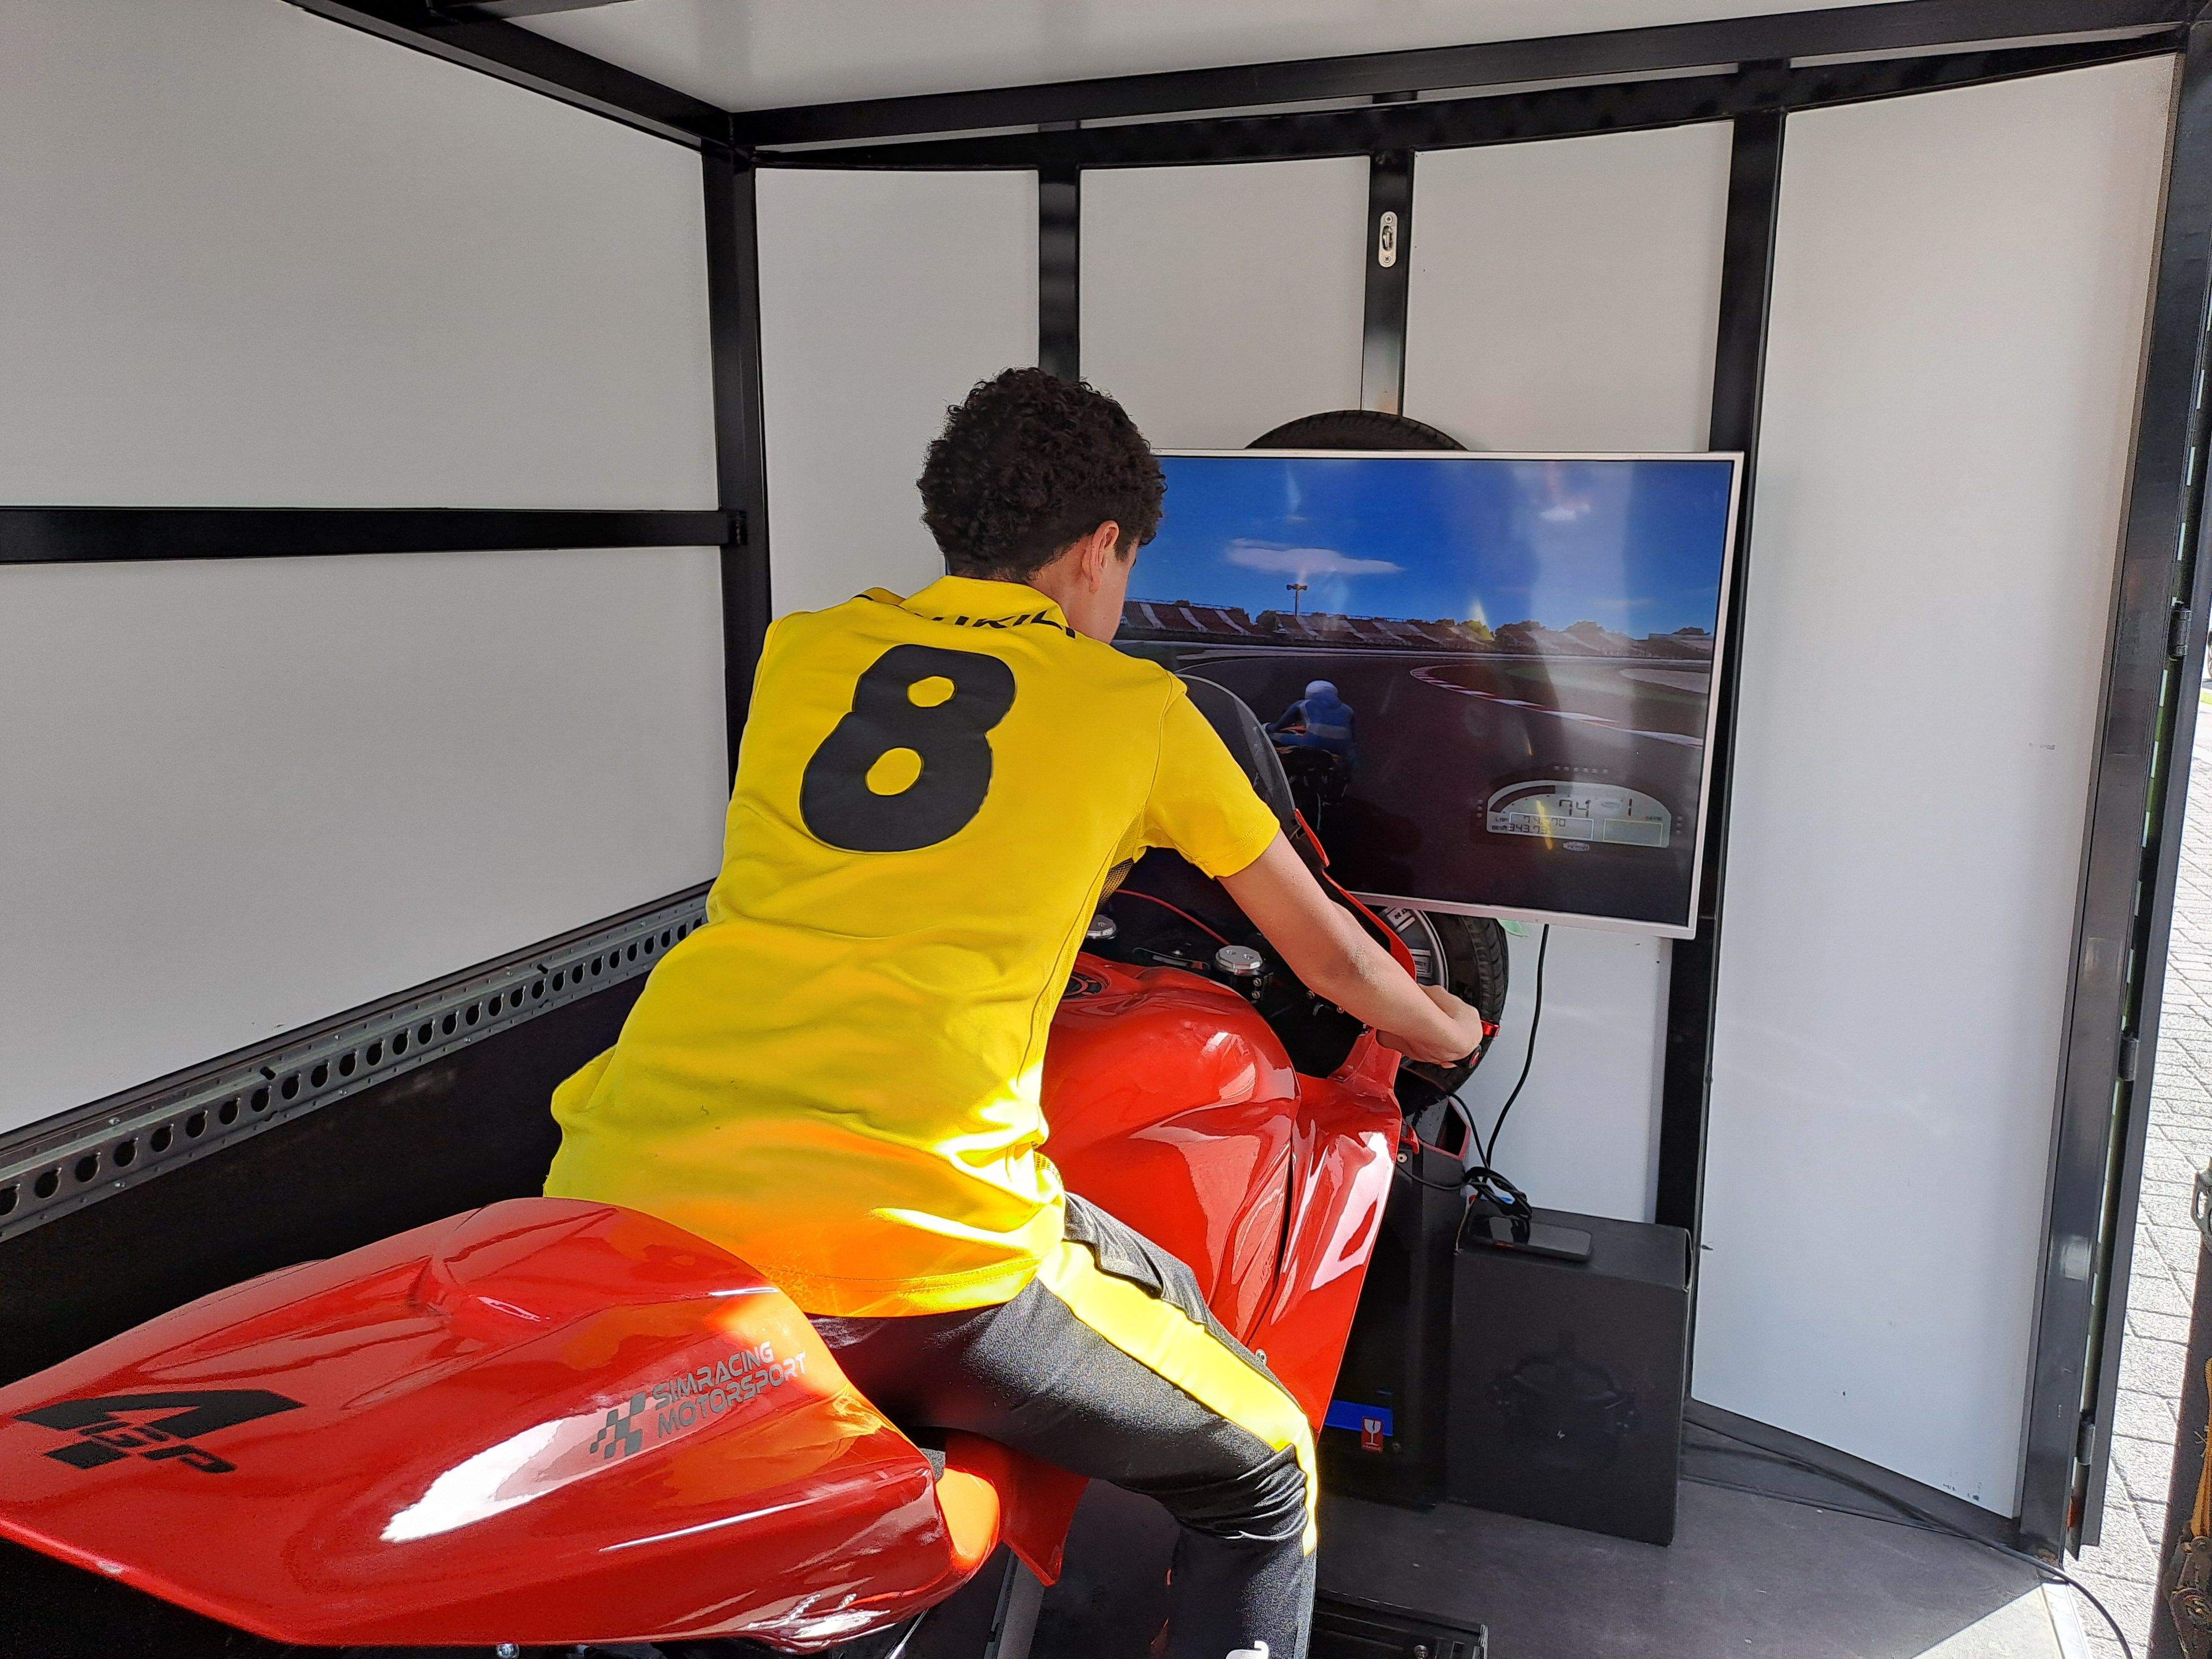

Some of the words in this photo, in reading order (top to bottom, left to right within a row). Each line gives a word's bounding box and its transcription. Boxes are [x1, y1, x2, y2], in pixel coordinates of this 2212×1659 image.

[800, 644, 1016, 852] 8
[652, 1340, 774, 1410] SIMRACING
[658, 1350, 807, 1437] MOTORSPORT
